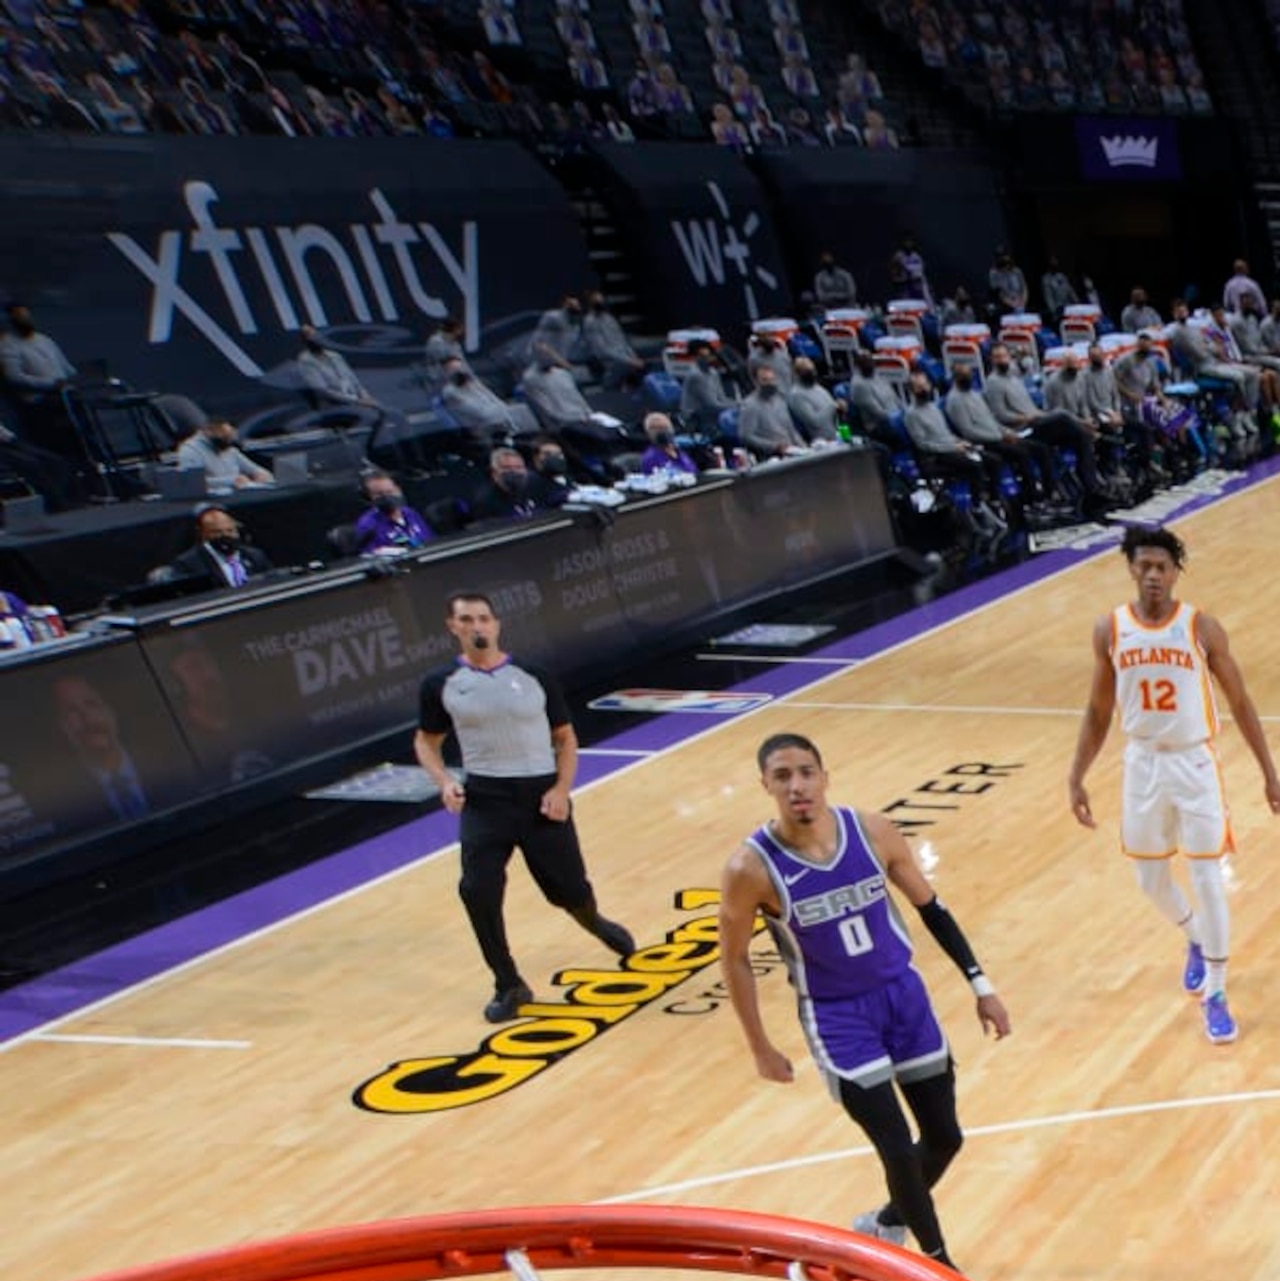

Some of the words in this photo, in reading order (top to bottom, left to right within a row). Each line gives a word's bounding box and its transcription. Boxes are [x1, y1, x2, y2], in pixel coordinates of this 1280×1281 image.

[106, 180, 480, 378] xfinity
[611, 532, 655, 562] ROSS
[244, 635, 285, 664] THE
[284, 606, 396, 651] CARMICHAEL
[292, 624, 405, 697] DAVE
[1120, 647, 1195, 671] ATLANTA
[1139, 679, 1177, 712] 12
[790, 873, 888, 927] SAC
[837, 916, 874, 956] 0
